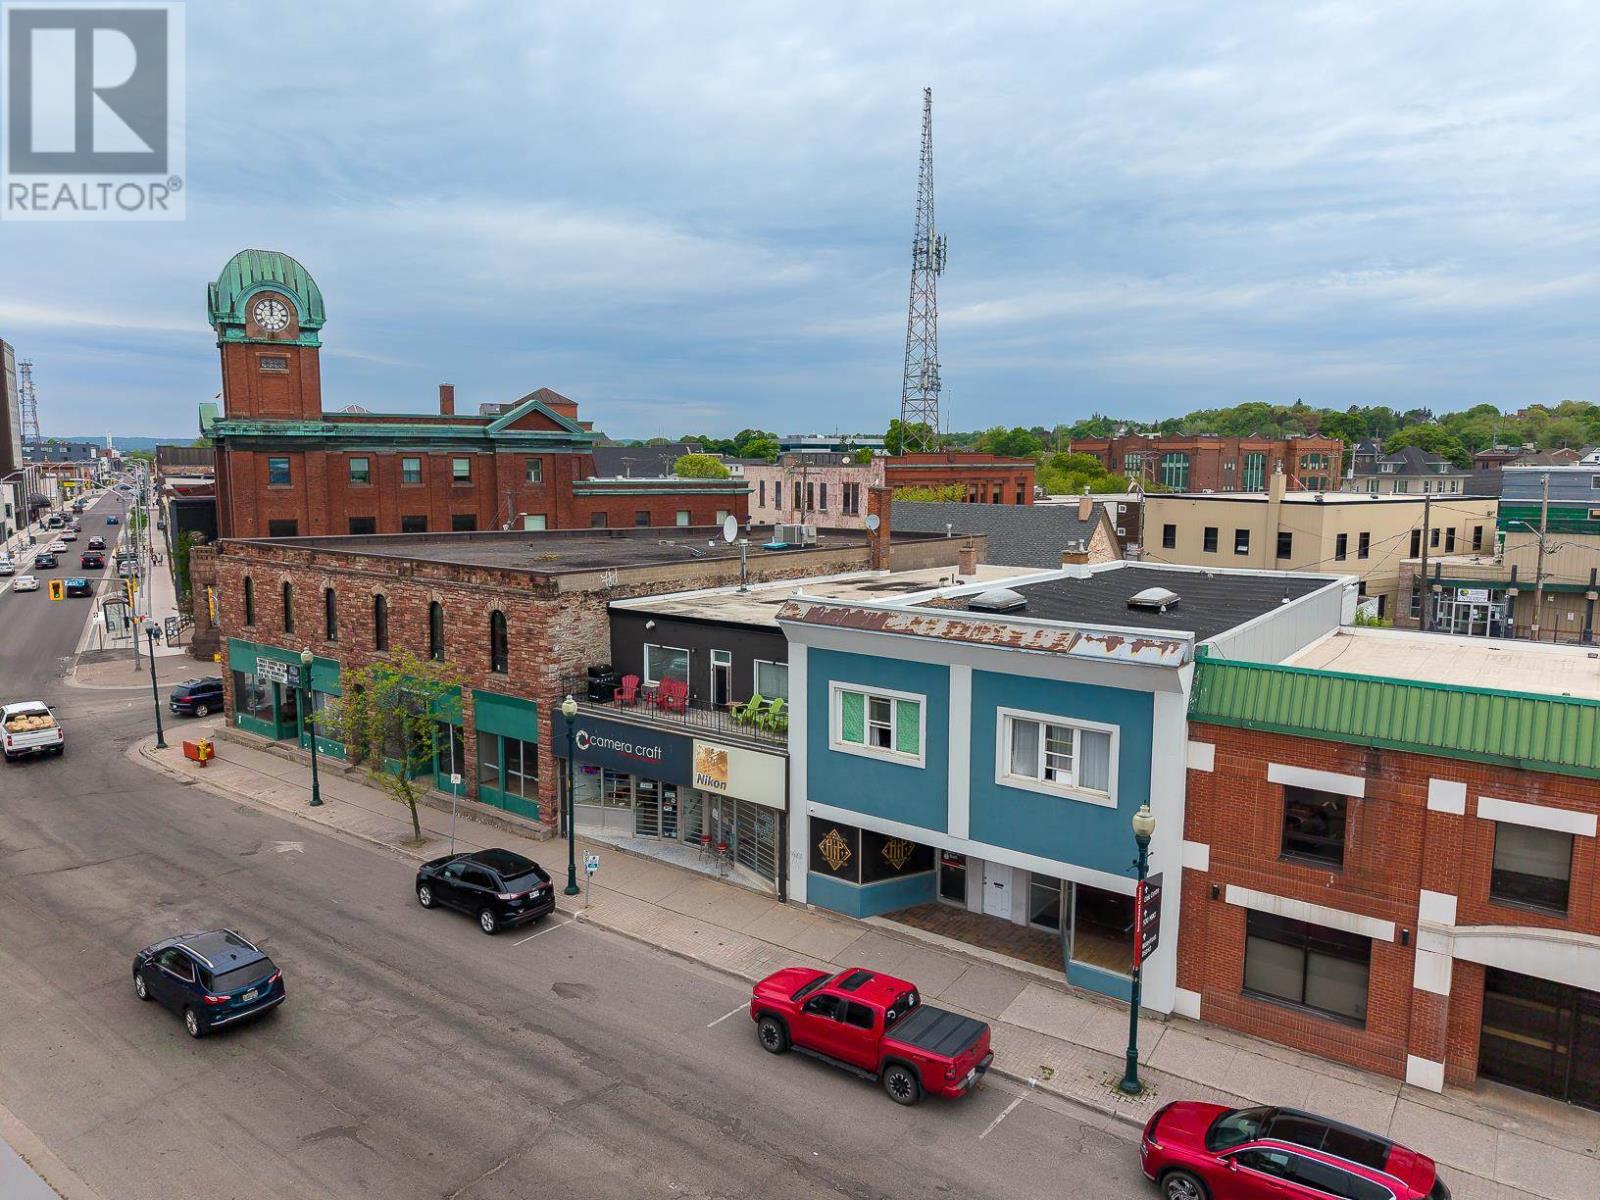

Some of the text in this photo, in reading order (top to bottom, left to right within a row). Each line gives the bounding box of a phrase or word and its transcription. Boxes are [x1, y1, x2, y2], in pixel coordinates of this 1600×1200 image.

[589, 735, 662, 760] camera craft
[696, 773, 728, 791] Nikon
